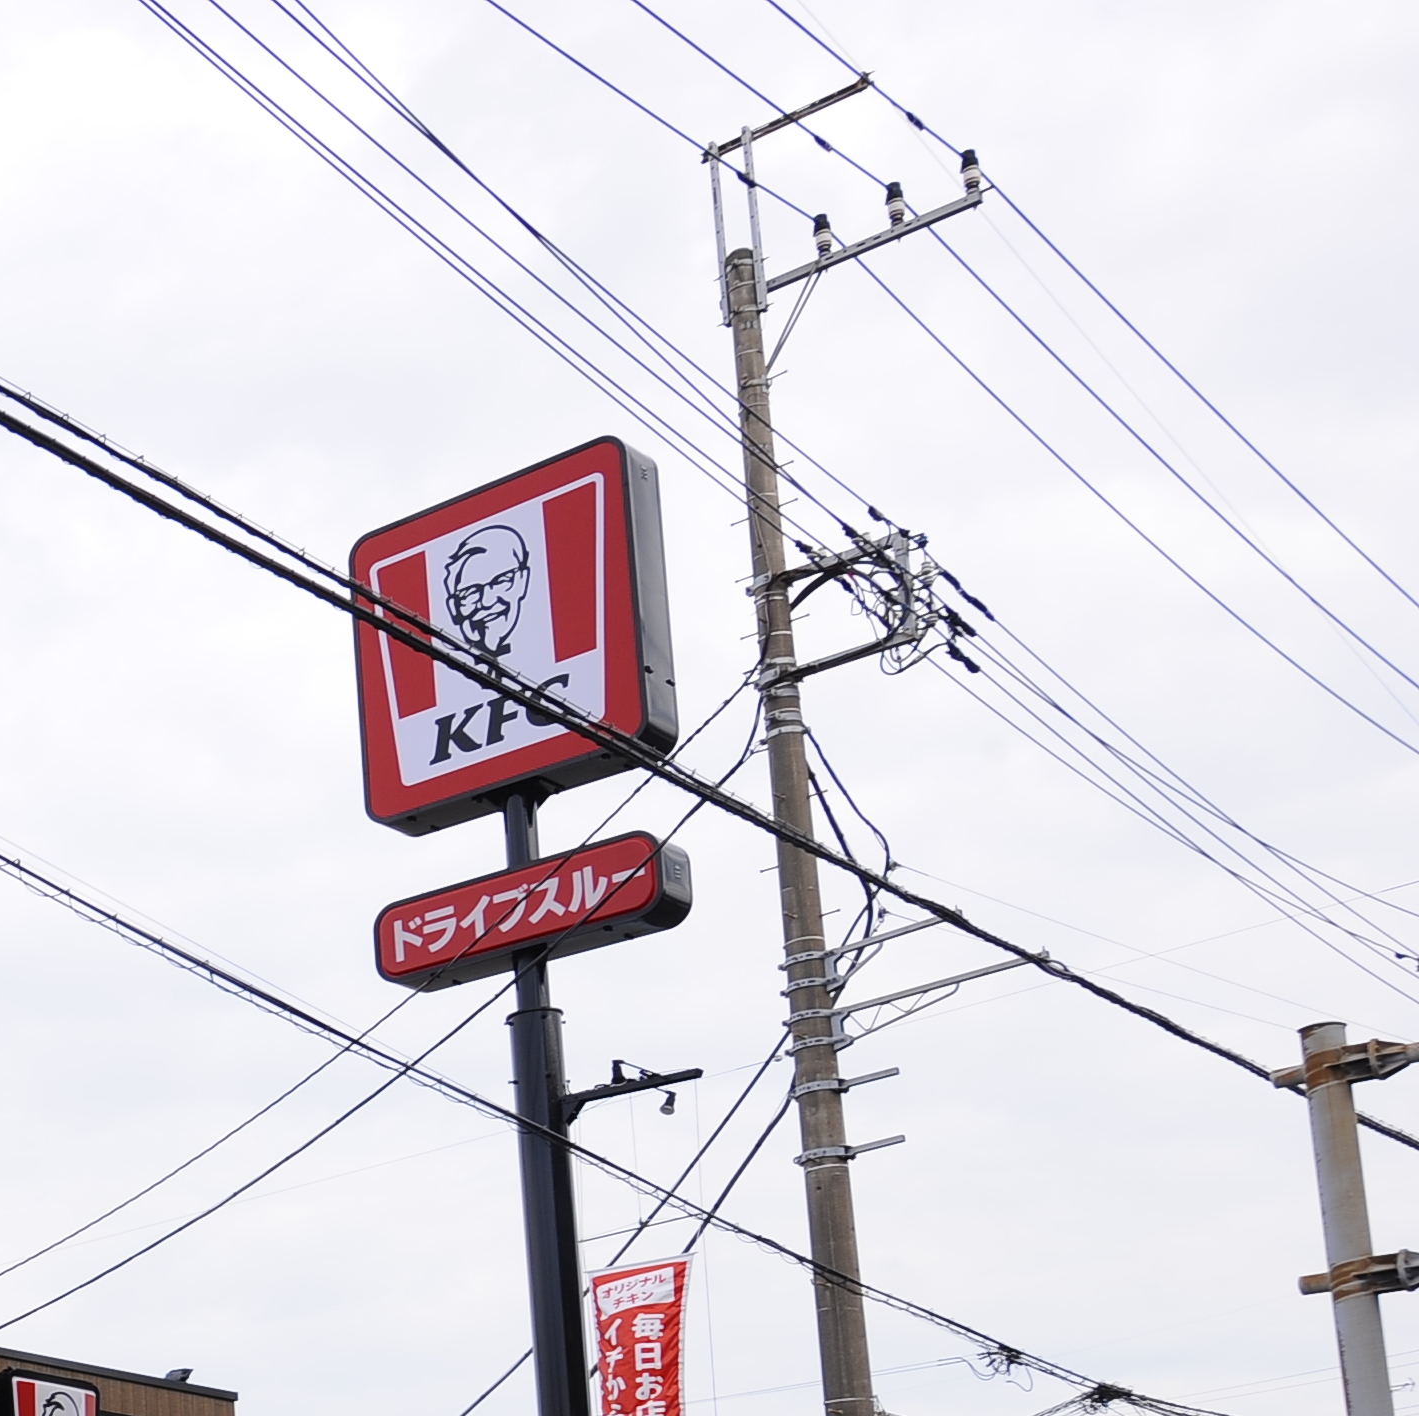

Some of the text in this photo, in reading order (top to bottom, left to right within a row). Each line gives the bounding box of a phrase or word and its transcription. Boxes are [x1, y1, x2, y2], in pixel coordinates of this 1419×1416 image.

[428, 673, 571, 766] KFC
[391, 864, 647, 963] ドライブスルー
[601, 1273, 666, 1301] オリジナル
[612, 1290, 654, 1309] チキン
